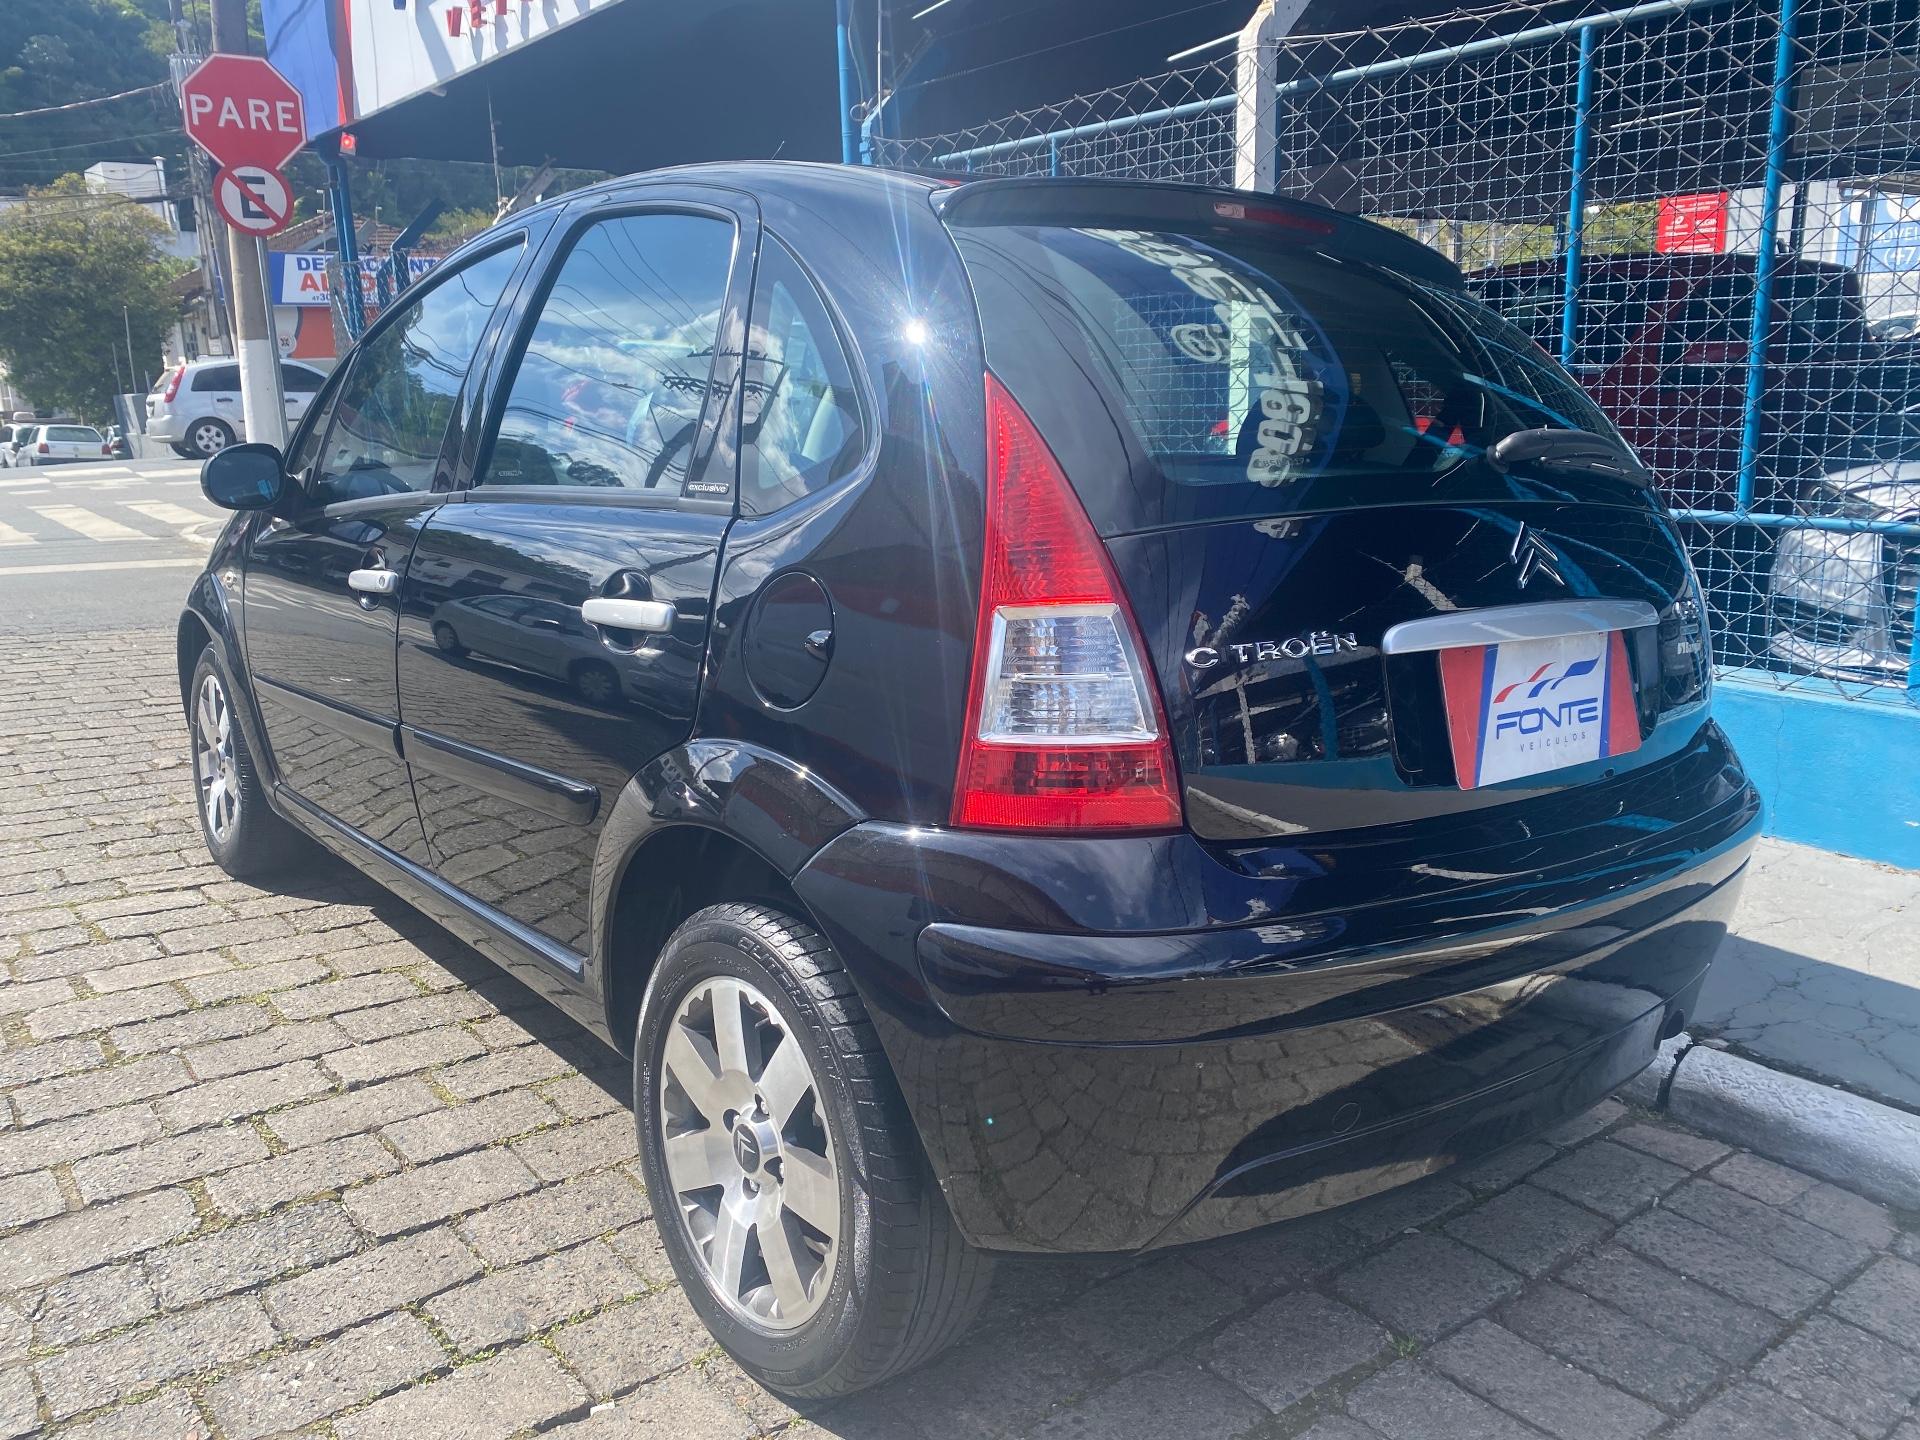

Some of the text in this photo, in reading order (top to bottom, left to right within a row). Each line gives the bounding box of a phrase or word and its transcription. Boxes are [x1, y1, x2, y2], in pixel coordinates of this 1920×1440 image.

[189, 93, 299, 133] PARE
[237, 175, 270, 219] E
[688, 483, 727, 493] exclusive
[1496, 697, 1599, 740] FONTE
